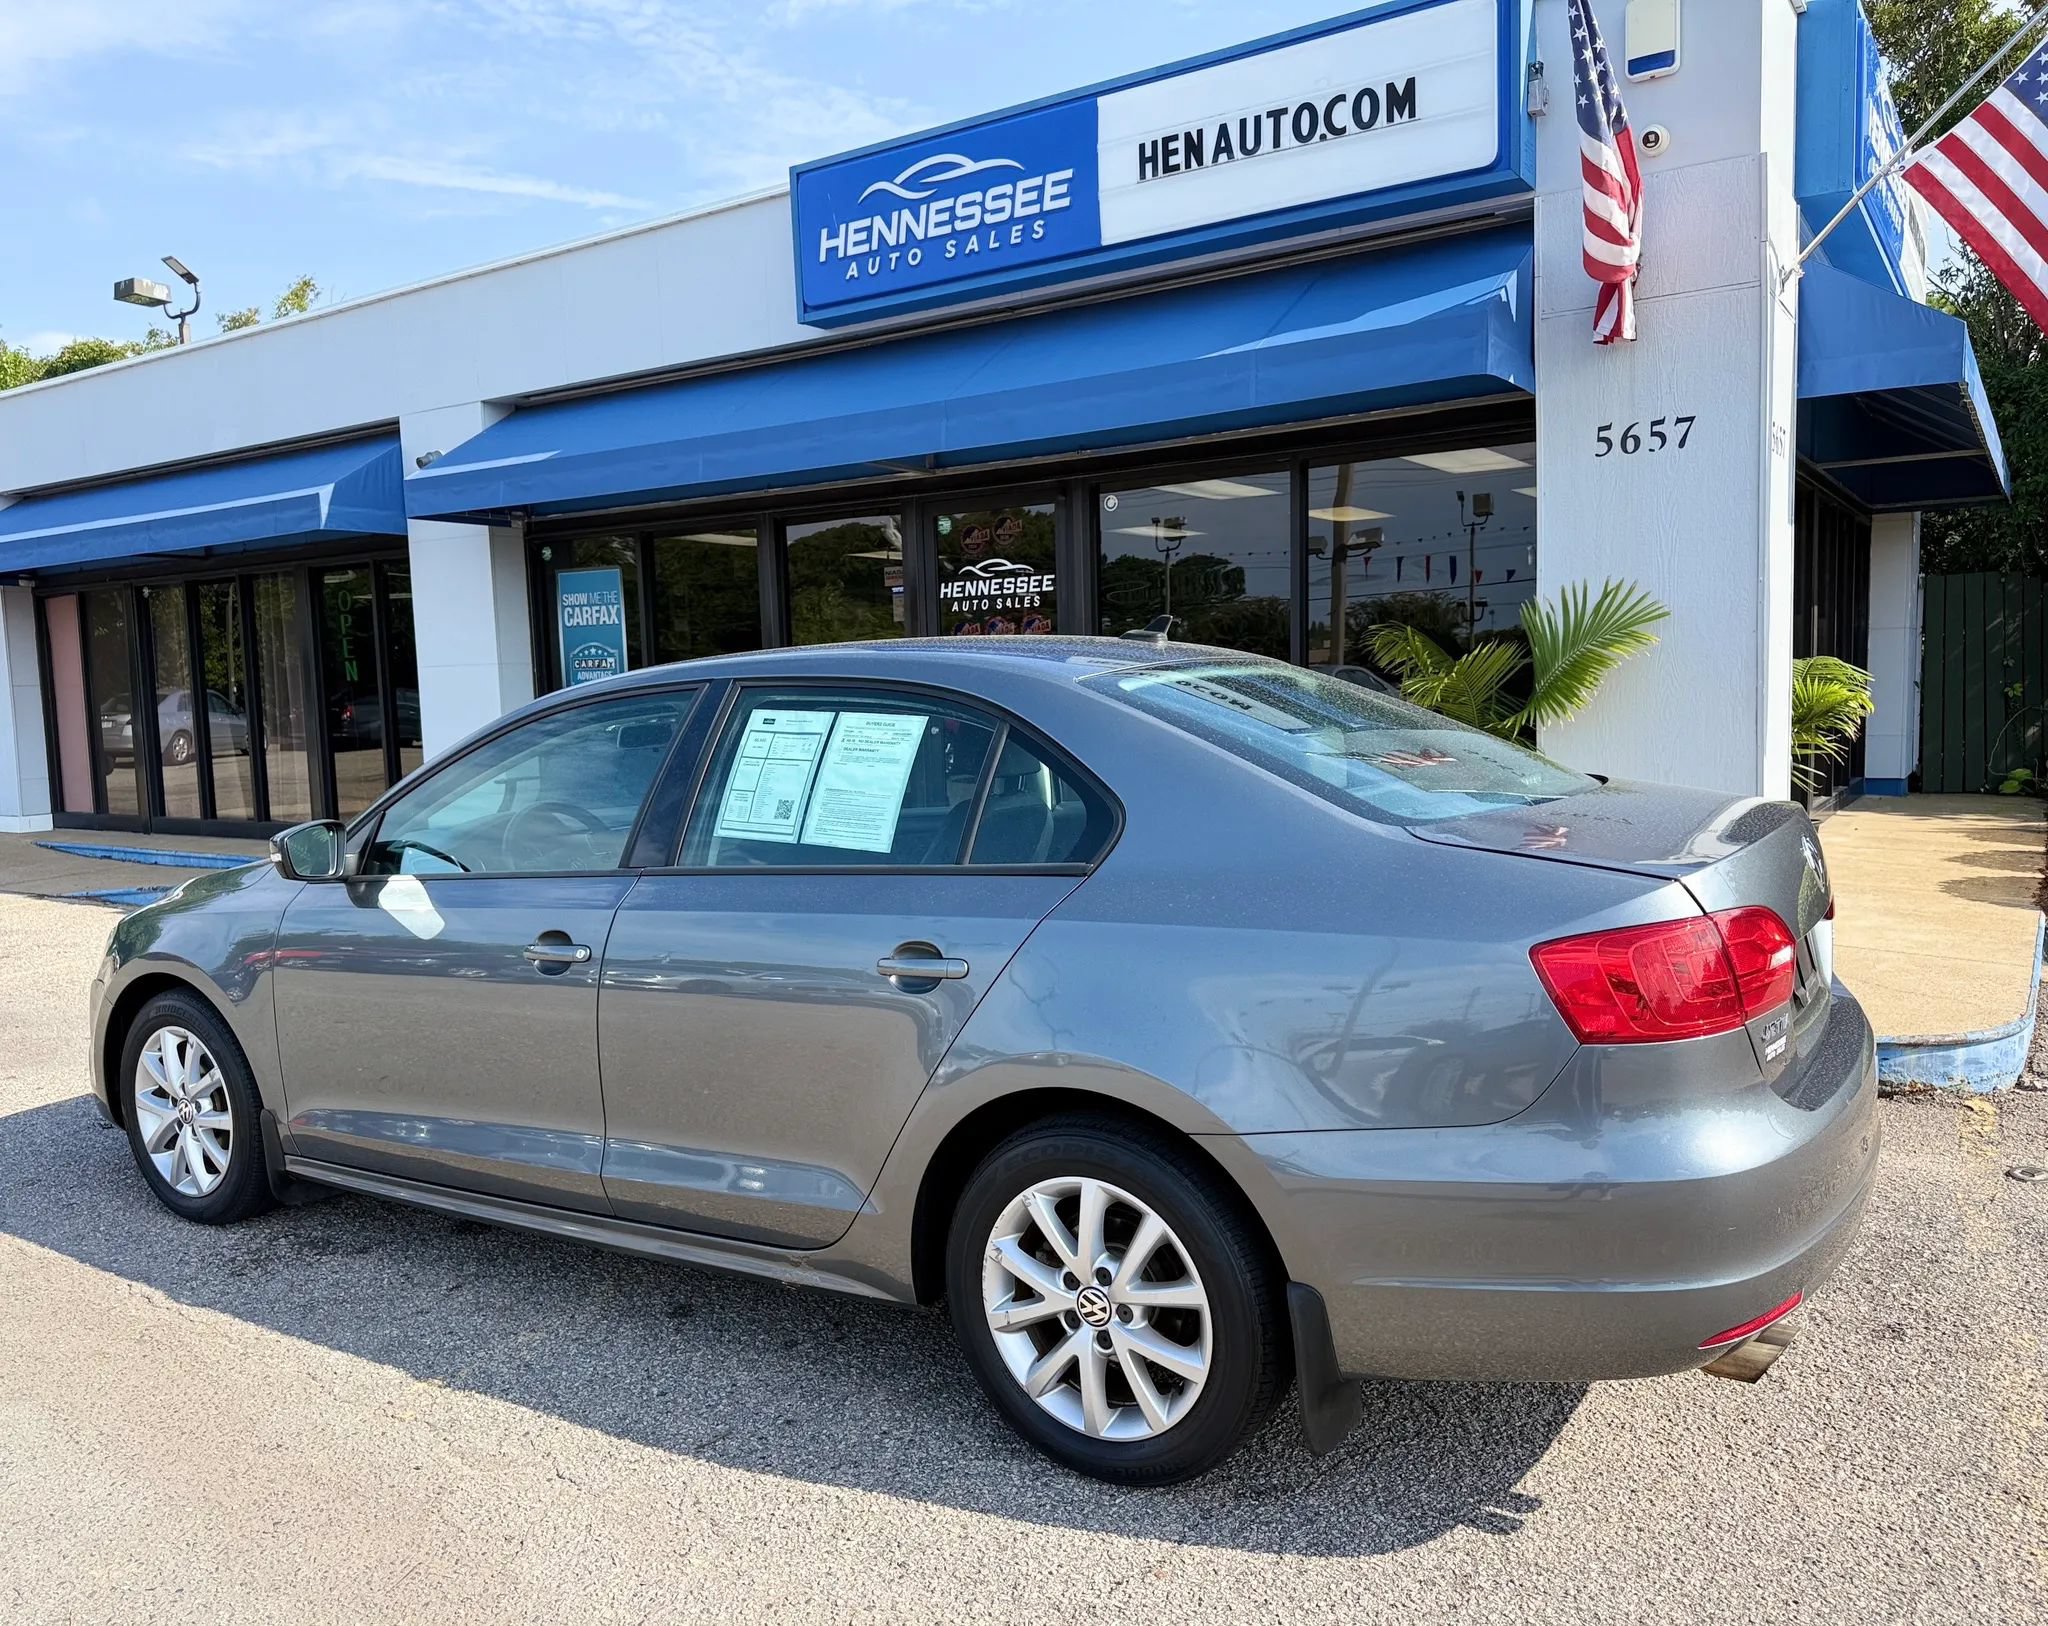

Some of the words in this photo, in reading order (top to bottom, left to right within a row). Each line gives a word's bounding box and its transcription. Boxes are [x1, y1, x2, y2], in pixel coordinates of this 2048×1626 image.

[818, 168, 1074, 263] HENNESSEE
[845, 248, 922, 281] AUTO
[944, 219, 1045, 259] SALES
[1594, 415, 1697, 458] 5657
[562, 593, 588, 607] SHOW
[588, 592, 602, 605] ME
[603, 590, 618, 604] THE
[940, 574, 1056, 599] HENNESSEE
[564, 605, 620, 627] CARFAX
[952, 599, 989, 613] AUTO
[996, 595, 1041, 610] SALES
[338, 590, 359, 682] OPEN
[574, 658, 616, 669] CARFAX
